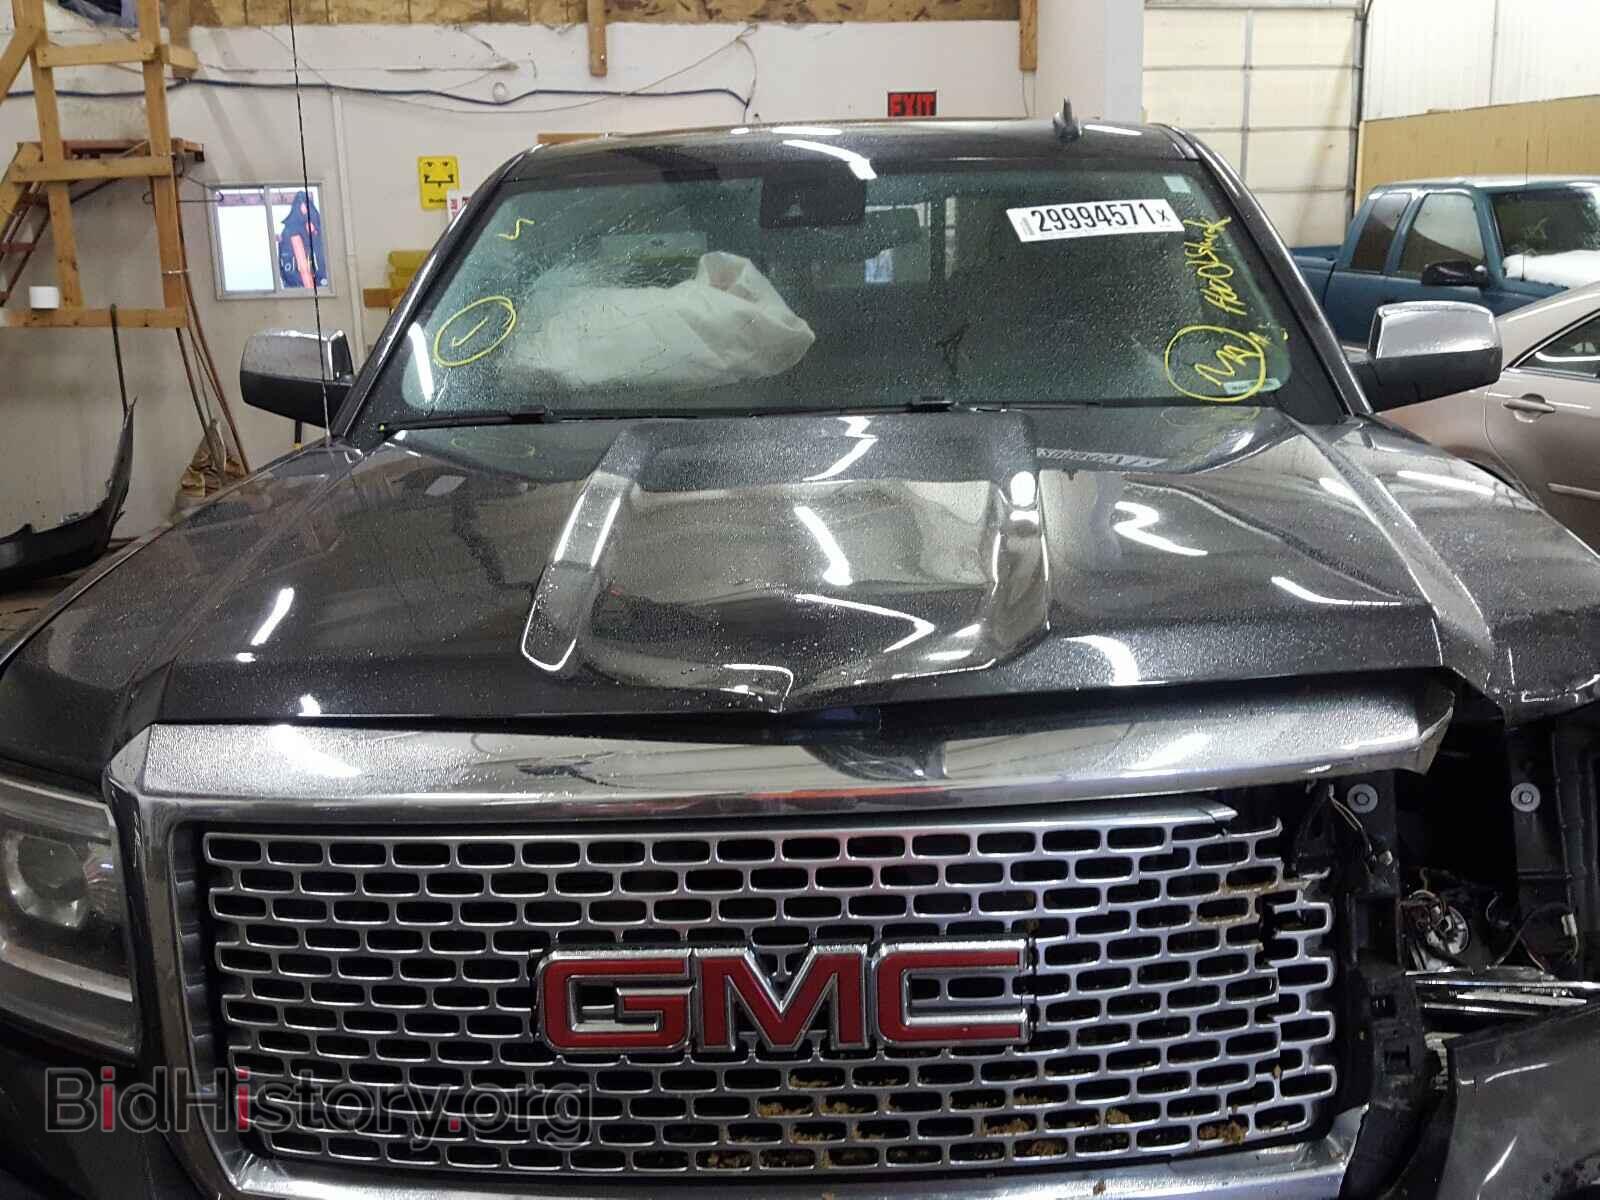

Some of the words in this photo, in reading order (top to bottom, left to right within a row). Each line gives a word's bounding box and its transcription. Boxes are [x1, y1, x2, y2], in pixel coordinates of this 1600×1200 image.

[889, 94, 934, 117] EXIT
[1031, 203, 1156, 232] 29994571
[537, 939, 1030, 1055] GMC
